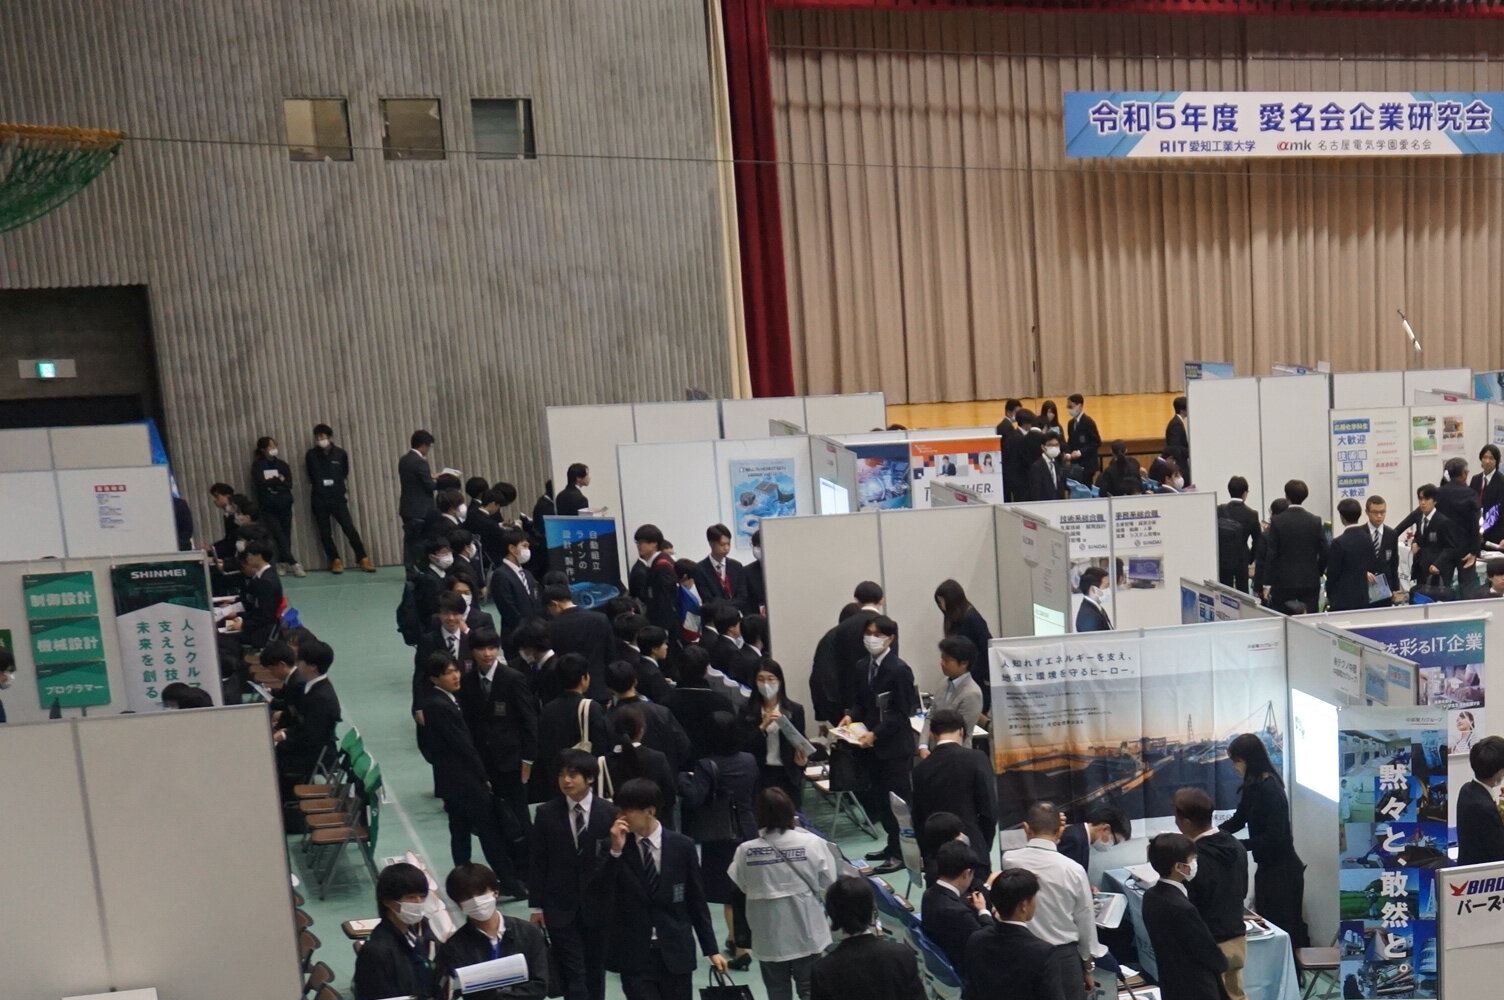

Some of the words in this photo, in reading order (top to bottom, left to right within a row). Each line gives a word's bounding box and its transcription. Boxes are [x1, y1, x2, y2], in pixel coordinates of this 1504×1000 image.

[1090, 101, 1239, 133] 令和5年度
[1259, 101, 1493, 133] 愛名会企業研究会
[1189, 139, 1256, 152] 愛知工業大学
[1317, 139, 1432, 151] 名古屋電気学園愛名会
[576, 530, 588, 570] ラインの
[130, 568, 187, 580] SHINMEI
[30, 591, 92, 608] 制御設計
[37, 635, 99, 653] 機械設計
[158, 620, 180, 682] 支える技
[136, 621, 160, 699] 未来を創る
[1001, 652, 1133, 669] 人知れずエネルギーを支え、
[1001, 667, 1135, 683] 地道に環境を守るヒーロー。
[45, 684, 104, 696] プログラマー
[1379, 764, 1409, 974] 黙々と、敢然と。
